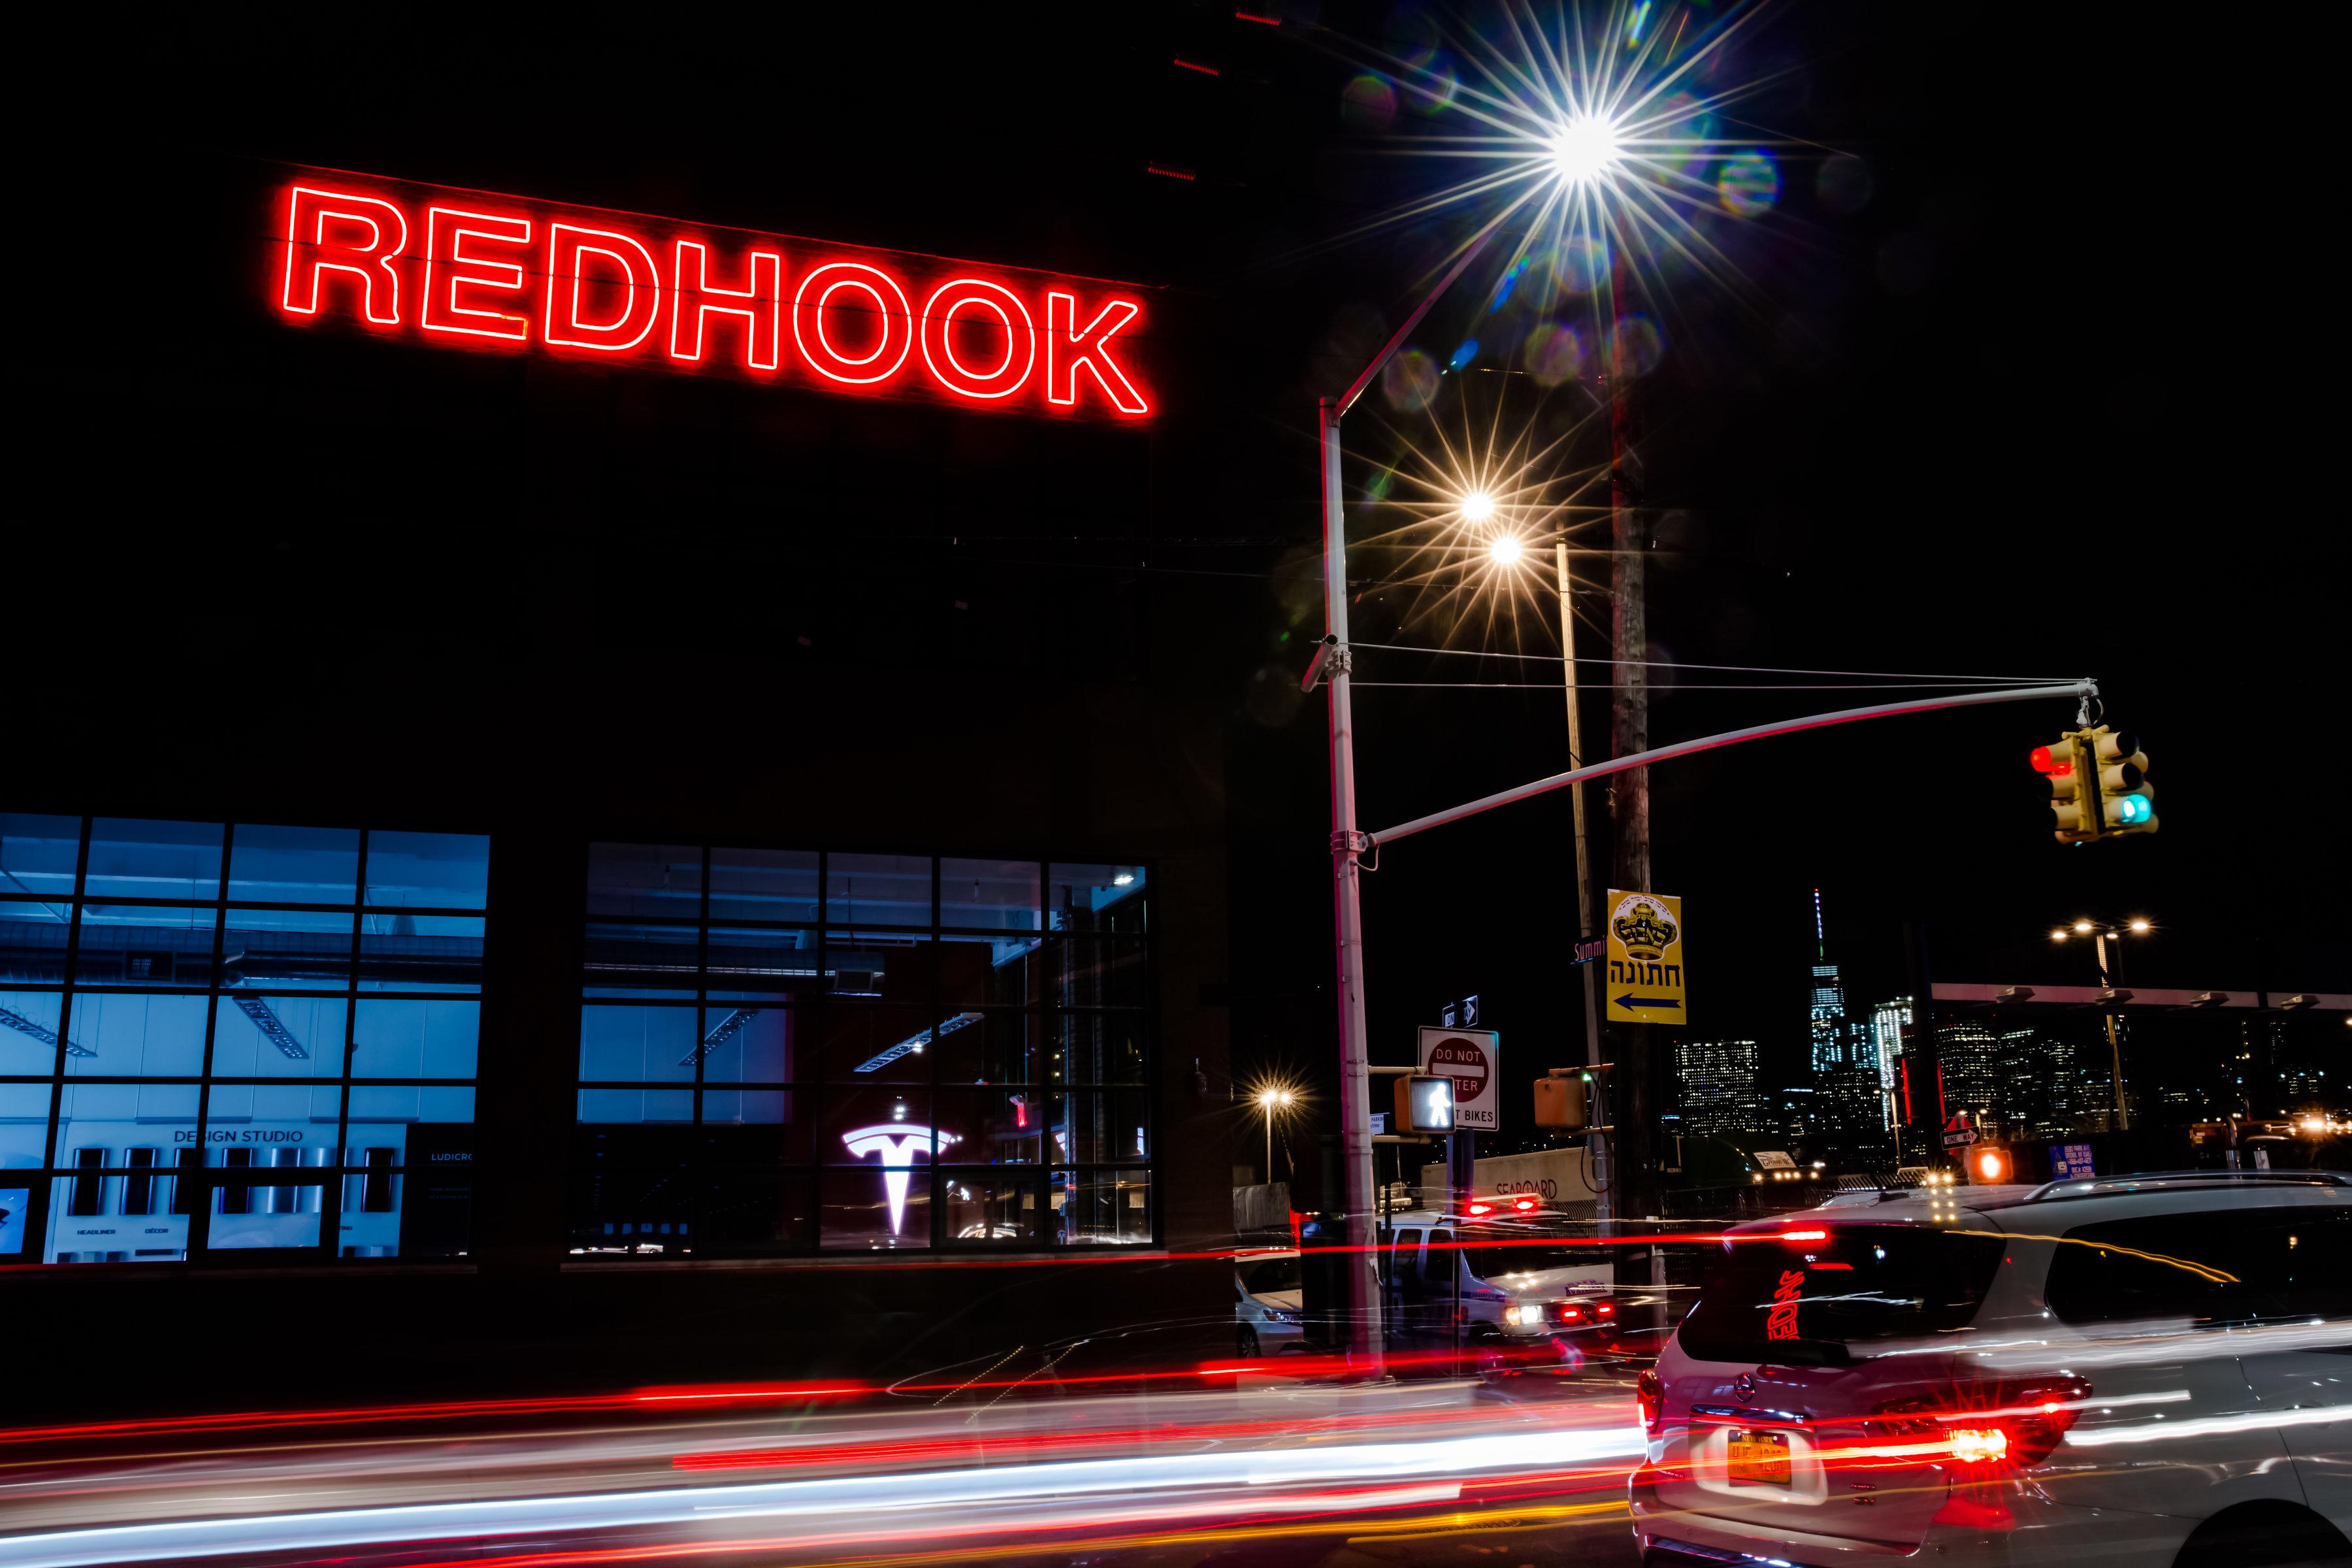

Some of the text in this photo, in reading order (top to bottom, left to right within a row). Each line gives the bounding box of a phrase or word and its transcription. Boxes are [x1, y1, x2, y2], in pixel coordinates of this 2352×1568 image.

[281, 185, 1149, 416] REDHOOK
[1574, 934, 1605, 962] Summi
[1610, 960, 1680, 987] חתונה
[1437, 1049, 1480, 1062] DO NOT
[1454, 1079, 1478, 1091] TER
[1465, 1110, 1494, 1122] BIKES
[174, 1130, 303, 1142] DEIGN STUDIO
[1947, 1132, 1974, 1143] ONE WAY
[1496, 1179, 1558, 1200] SEABOARD
[1741, 1434, 1773, 1445] NEW YORK
